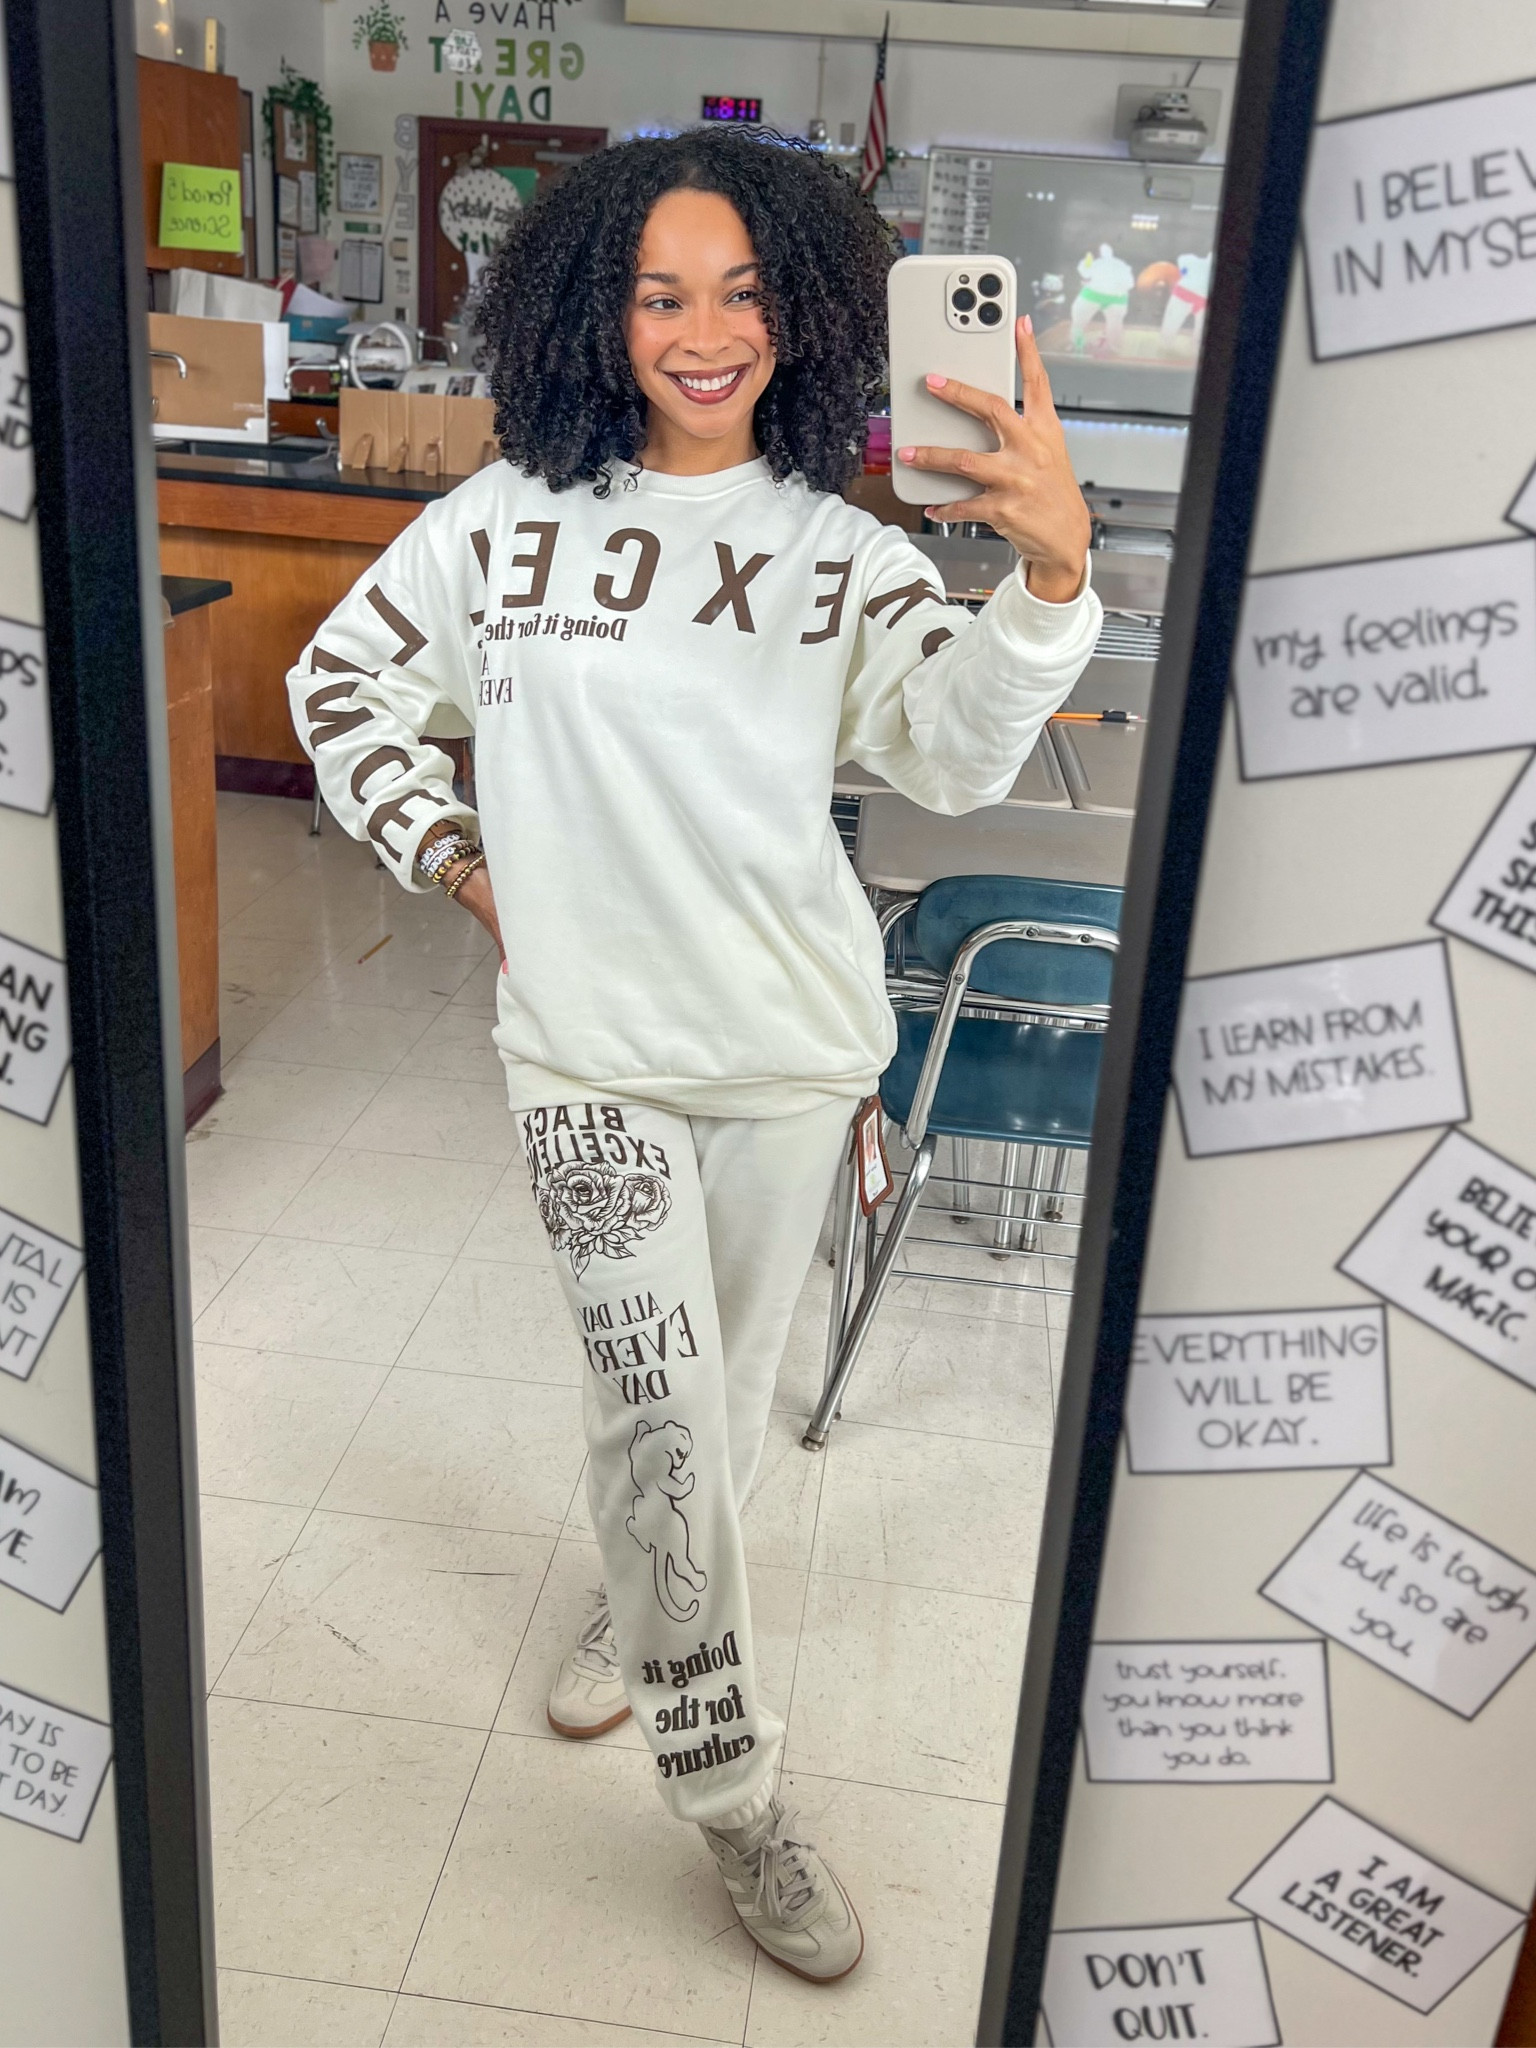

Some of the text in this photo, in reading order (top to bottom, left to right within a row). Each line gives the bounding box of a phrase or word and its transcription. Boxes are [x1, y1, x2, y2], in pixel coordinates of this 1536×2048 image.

[1334, 241, 1382, 296] IN
[1253, 599, 1518, 671] my feelings
[1289, 656, 1489, 718] are valid.
[1221, 1013, 1313, 1056] LEARN
[1325, 999, 1423, 1042] FROM
[1202, 1068, 1255, 1106] MY
[2, 1280, 36, 1314] IS
[1175, 1371, 1333, 1407] WILL BE
[1197, 1415, 1319, 1449] OKAY.
[1338, 1539, 1489, 1645] but so are
[1409, 1530, 1441, 1563] is
[1443, 1549, 1531, 1623] tough
[1348, 1606, 1414, 1658] you
[1116, 1657, 1287, 1684] trust yourself.
[1103, 1690, 1304, 1713] you know more
[38, 1722, 65, 1747] IS
[1117, 1717, 1294, 1742] than you think
[9, 1743, 79, 1788] TO BE
[1163, 1751, 1211, 1770] you
[14, 1779, 68, 1818] DAY.
[1358, 1855, 1446, 1916] I AM
[1280, 1881, 1423, 1978] LISTENER.
[1314, 1869, 1445, 1949] A GREAT
[1112, 2002, 1209, 2042] QUIT.
